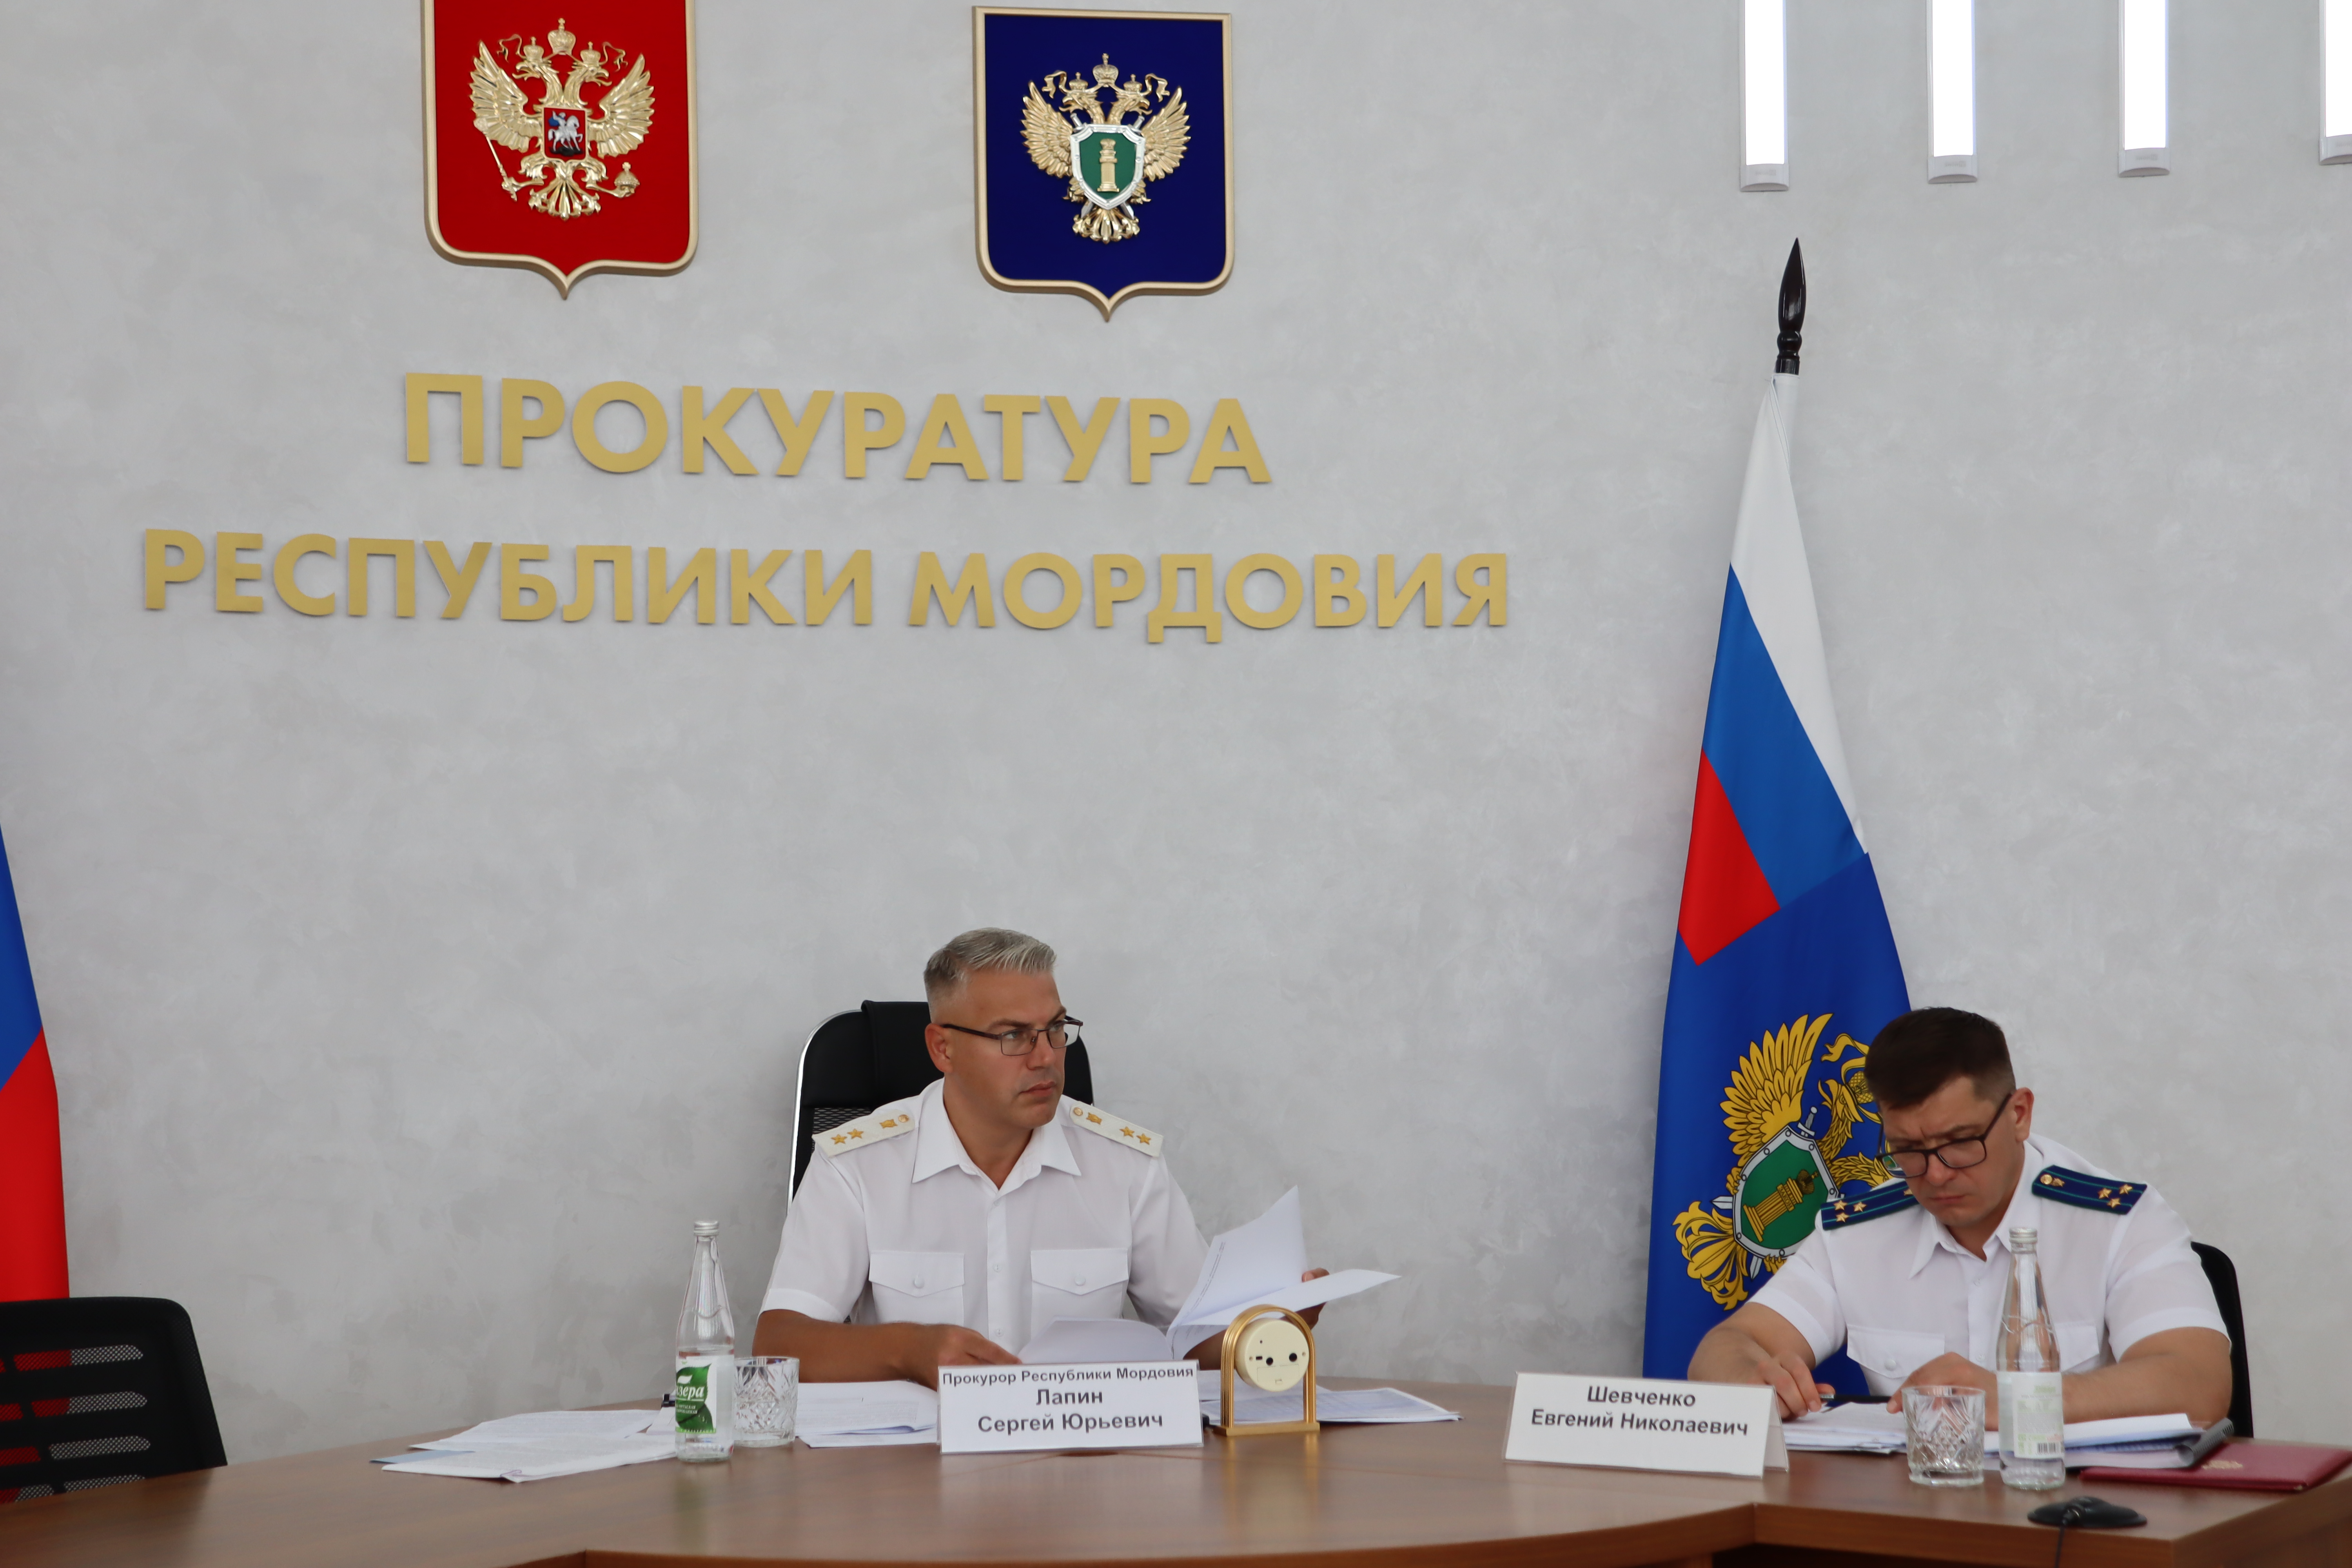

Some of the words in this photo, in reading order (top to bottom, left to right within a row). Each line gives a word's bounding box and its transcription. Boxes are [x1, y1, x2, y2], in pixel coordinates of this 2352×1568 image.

[405, 372, 1272, 484] ПРОКУРАТУРА
[145, 528, 873, 626] РЕСПУБЛИКИ
[908, 551, 1507, 643] МОРДОВИЯ
[942, 1372, 1017, 1387] Прокурор
[1021, 1370, 1112, 1384] Республики
[1116, 1367, 1194, 1381] Мордовия
[1035, 1388, 1103, 1405] Лапин
[1587, 1385, 1696, 1407] Шевченко
[977, 1414, 1054, 1436] Сергей
[1062, 1413, 1163, 1433] Юрьевич
[1531, 1408, 1613, 1429] Евгений
[1620, 1413, 1748, 1436] Николаевич
